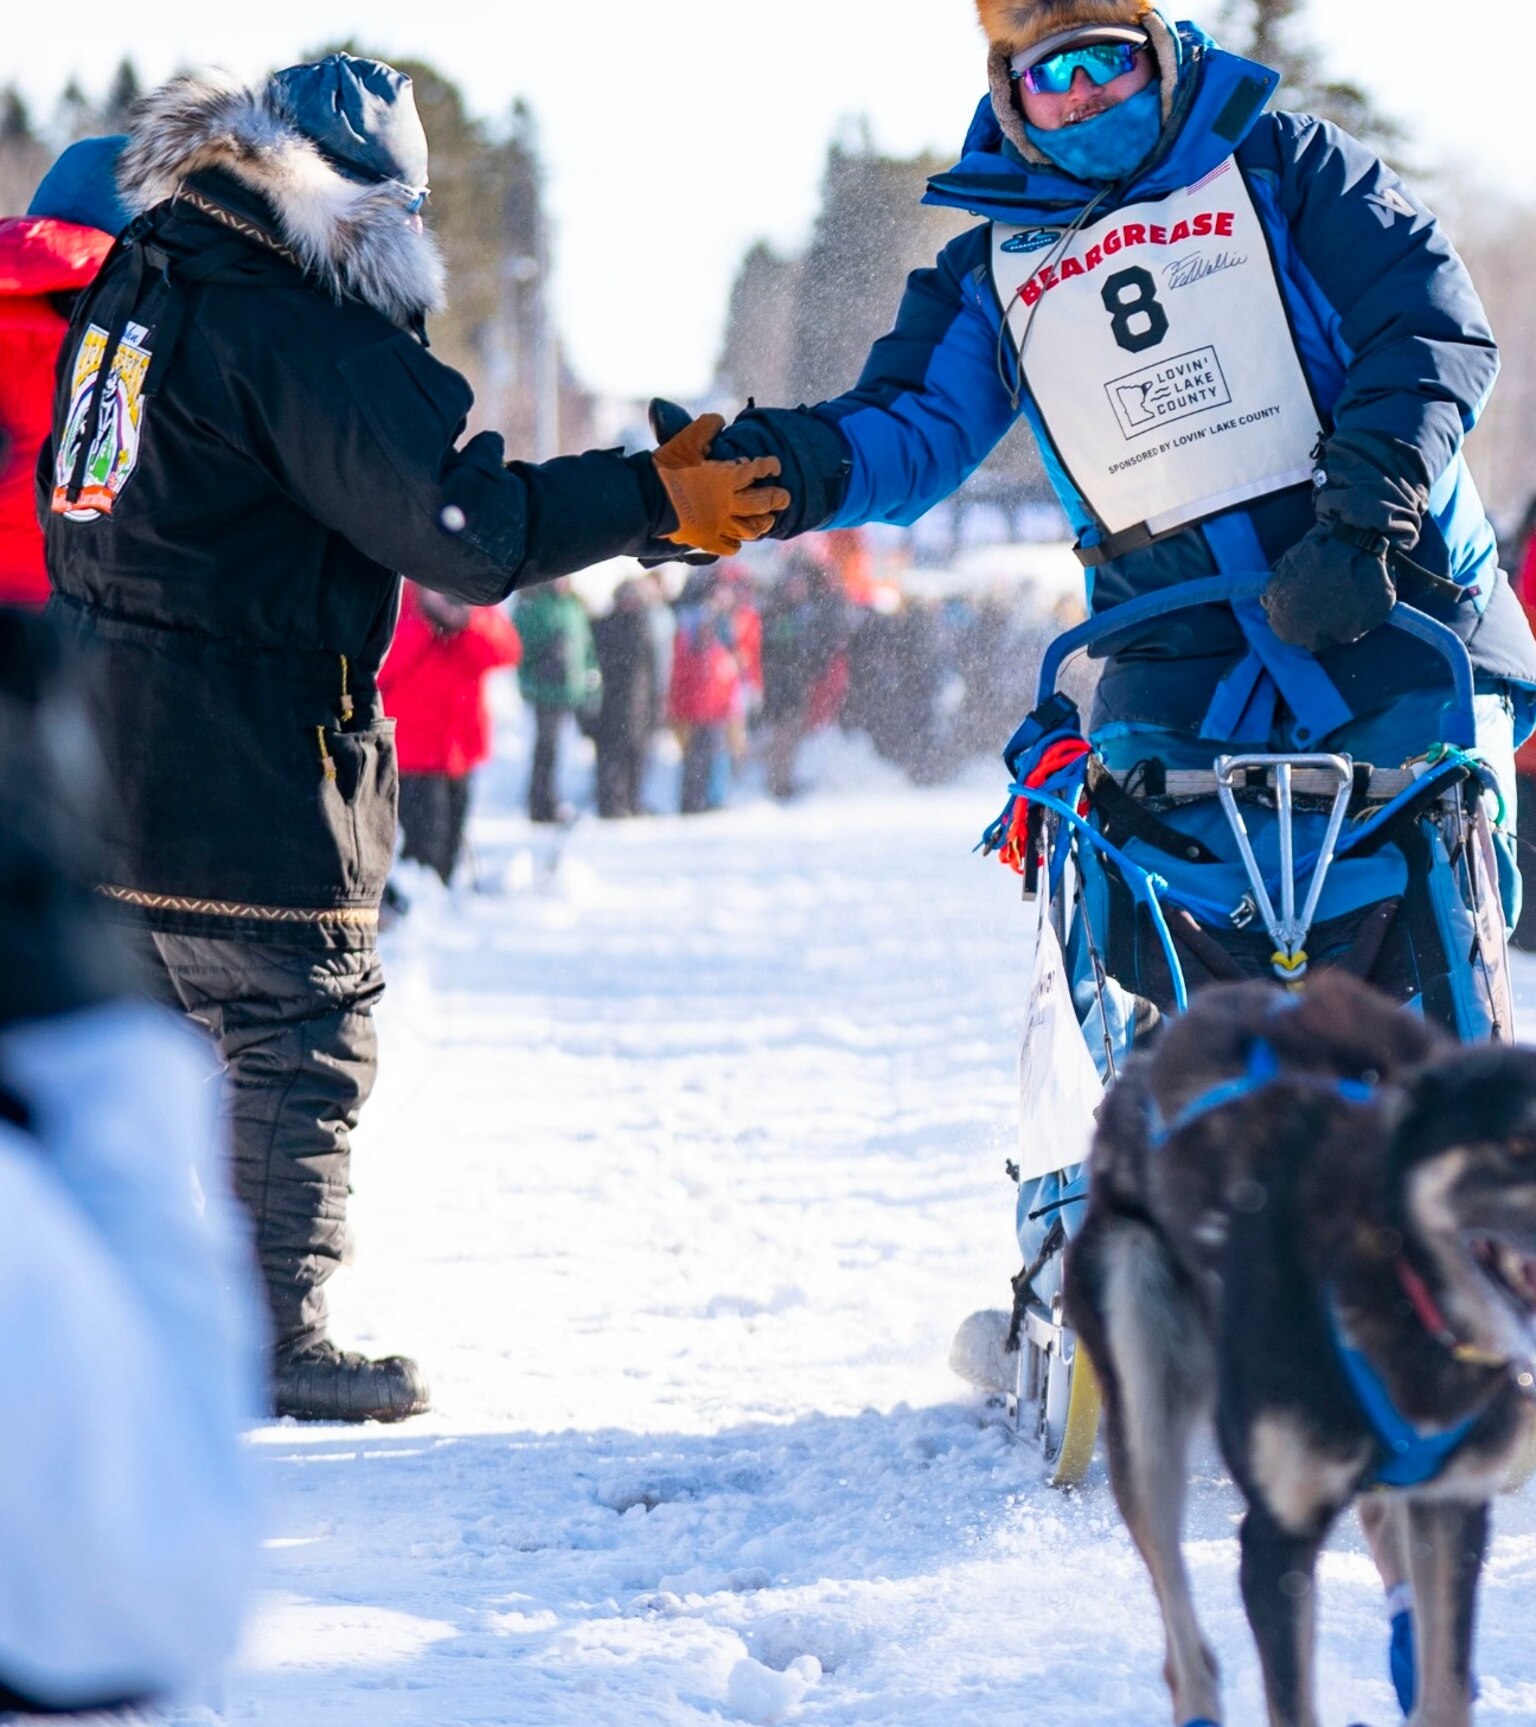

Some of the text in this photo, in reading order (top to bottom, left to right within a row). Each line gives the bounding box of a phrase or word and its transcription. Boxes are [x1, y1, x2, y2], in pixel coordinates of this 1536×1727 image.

[1016, 212, 1235, 307] BEARGREASE
[1101, 265, 1170, 353] 8
[1156, 357, 1208, 383] LOVIN'
[1174, 371, 1214, 393] LAKE
[1156, 386, 1217, 415] COUNTY
[1108, 405, 1281, 474] SPONSORED BY LOVIN' LAKE COUNTY
